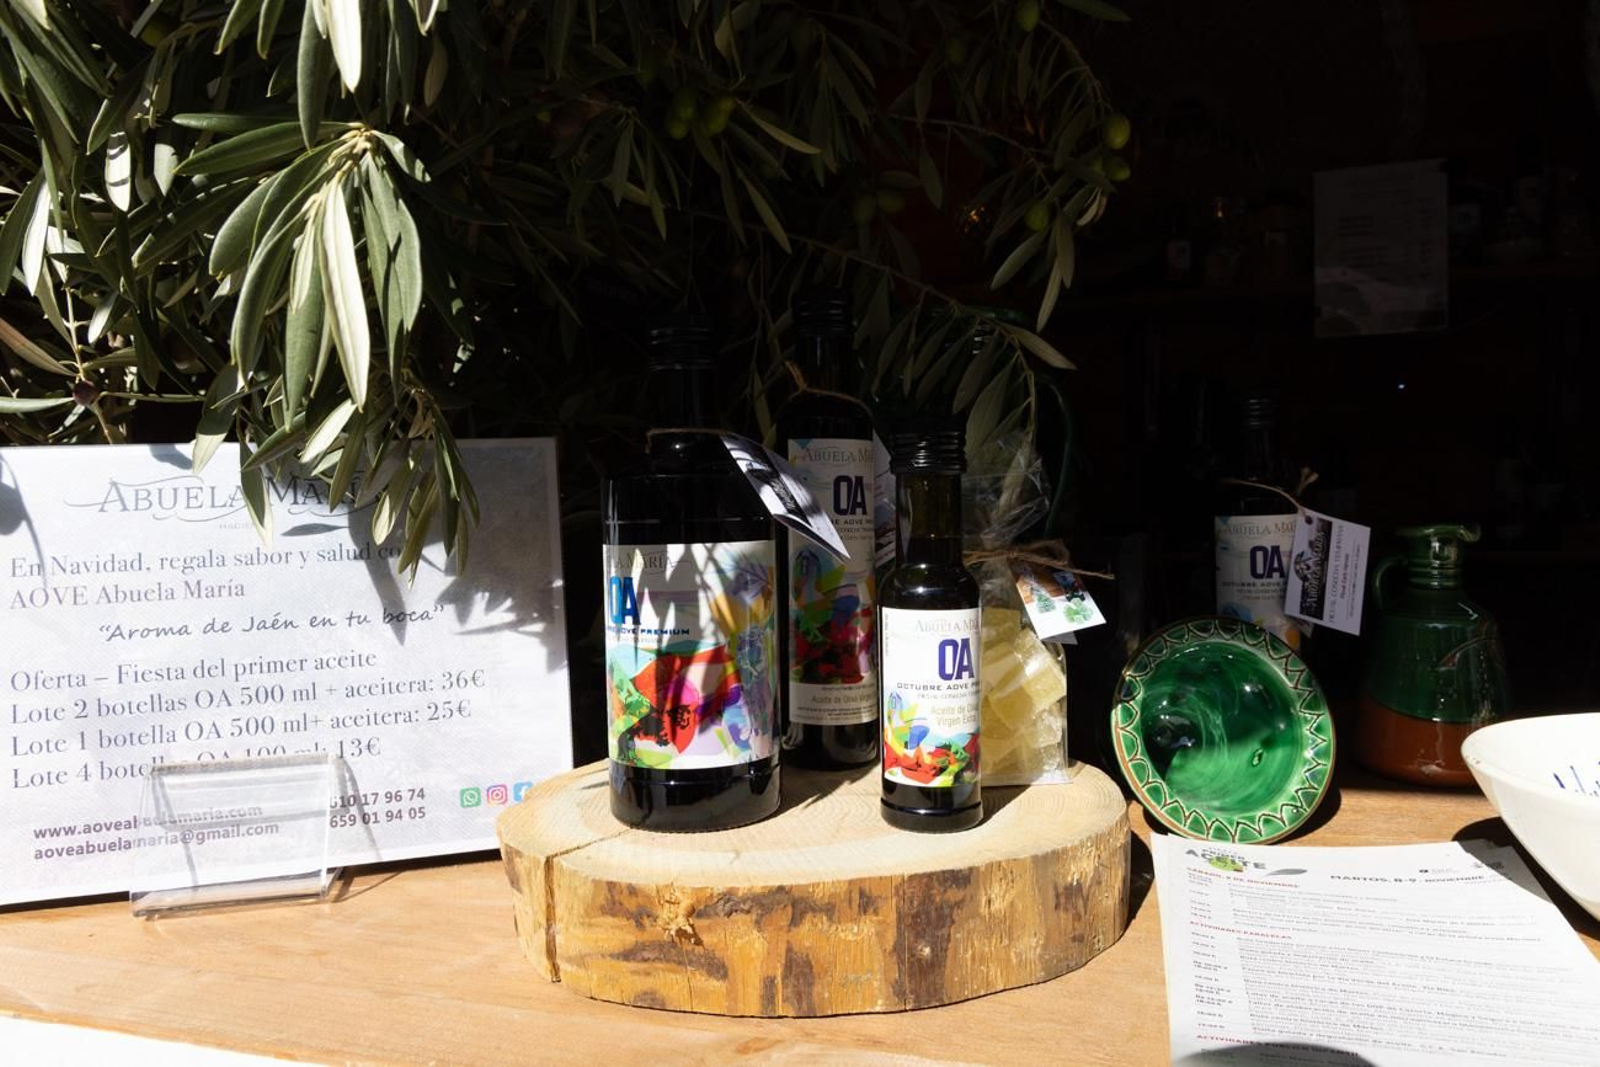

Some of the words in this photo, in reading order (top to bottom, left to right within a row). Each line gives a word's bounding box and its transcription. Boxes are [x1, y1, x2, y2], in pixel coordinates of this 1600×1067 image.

[98, 478, 245, 513] ABUELA
[833, 474, 867, 516] OA
[11, 557, 42, 578] En
[159, 549, 226, 575] regala
[234, 547, 292, 567] sabor
[299, 551, 313, 569] y
[316, 542, 370, 563] salud
[1250, 544, 1285, 579] OA
[10, 585, 88, 610] AOVE
[96, 581, 176, 604] Abuela
[184, 578, 246, 600] María
[610, 576, 641, 625] OA
[202, 617, 232, 634] de
[242, 612, 299, 633] Jaén
[310, 615, 337, 627] en
[345, 611, 371, 625] tu
[10, 669, 88, 692] Oferta
[118, 662, 185, 685] Fiesta
[192, 657, 226, 678] del
[233, 655, 308, 682] primer
[314, 649, 377, 671] aceite
[938, 638, 975, 681] OA
[10, 703, 66, 725] Lote
[73, 699, 89, 720] 2
[97, 693, 187, 717] botellas
[195, 688, 232, 710] OA
[240, 684, 284, 706] 500
[292, 681, 317, 703] ml
[325, 685, 338, 697] +
[344, 676, 434, 698] aceitera:
[442, 668, 486, 691] 36€
[896, 682, 943, 691] OCTUBRE
[945, 682, 969, 691] AOVE
[11, 736, 67, 757] Lote
[79, 730, 87, 751] 1
[99, 724, 176, 749] botella
[184, 720, 227, 742] OA
[230, 715, 275, 738] 500
[330, 708, 420, 730] aceitera:
[427, 698, 472, 722] 25€
[12, 768, 68, 789] Lote
[76, 762, 92, 782] 4
[337, 736, 381, 759] 13€
[361, 792, 379, 806] 17
[385, 790, 403, 803] 96
[408, 787, 426, 801] 74
[33, 823, 280, 861] aoveabuelamaria@gmail.com
[329, 814, 357, 828] 659
[362, 812, 380, 825] 01
[385, 809, 404, 823] 94
[408, 806, 426, 820] 05
